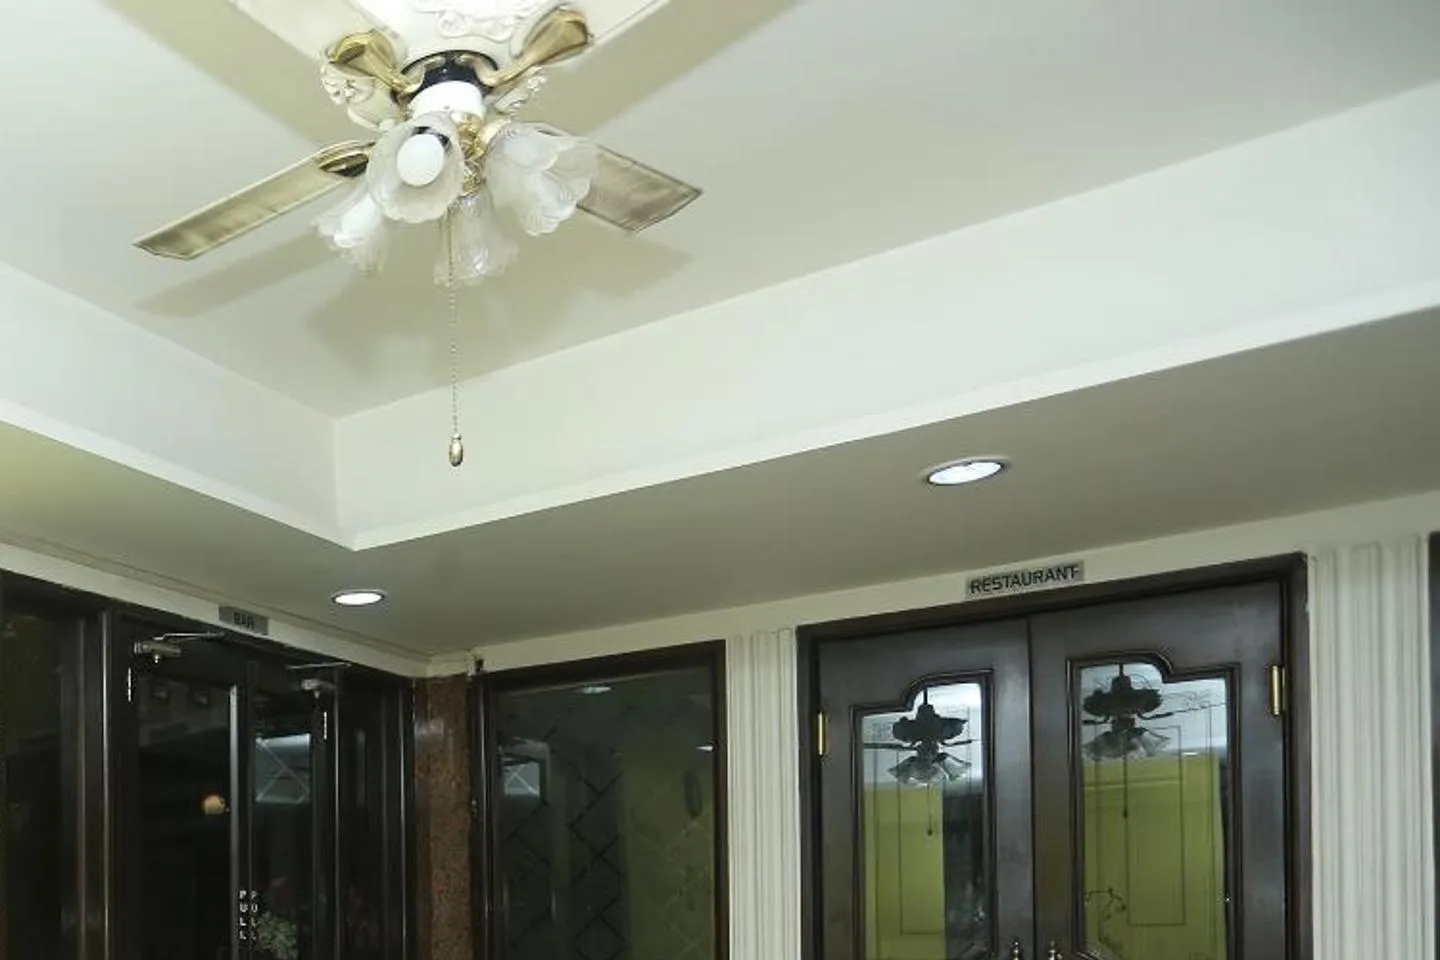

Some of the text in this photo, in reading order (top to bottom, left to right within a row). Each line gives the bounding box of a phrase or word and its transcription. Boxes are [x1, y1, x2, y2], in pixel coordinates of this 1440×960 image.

[969, 564, 1080, 594] RESTAURANT
[233, 611, 255, 630] BAR
[239, 890, 248, 940] PULL
